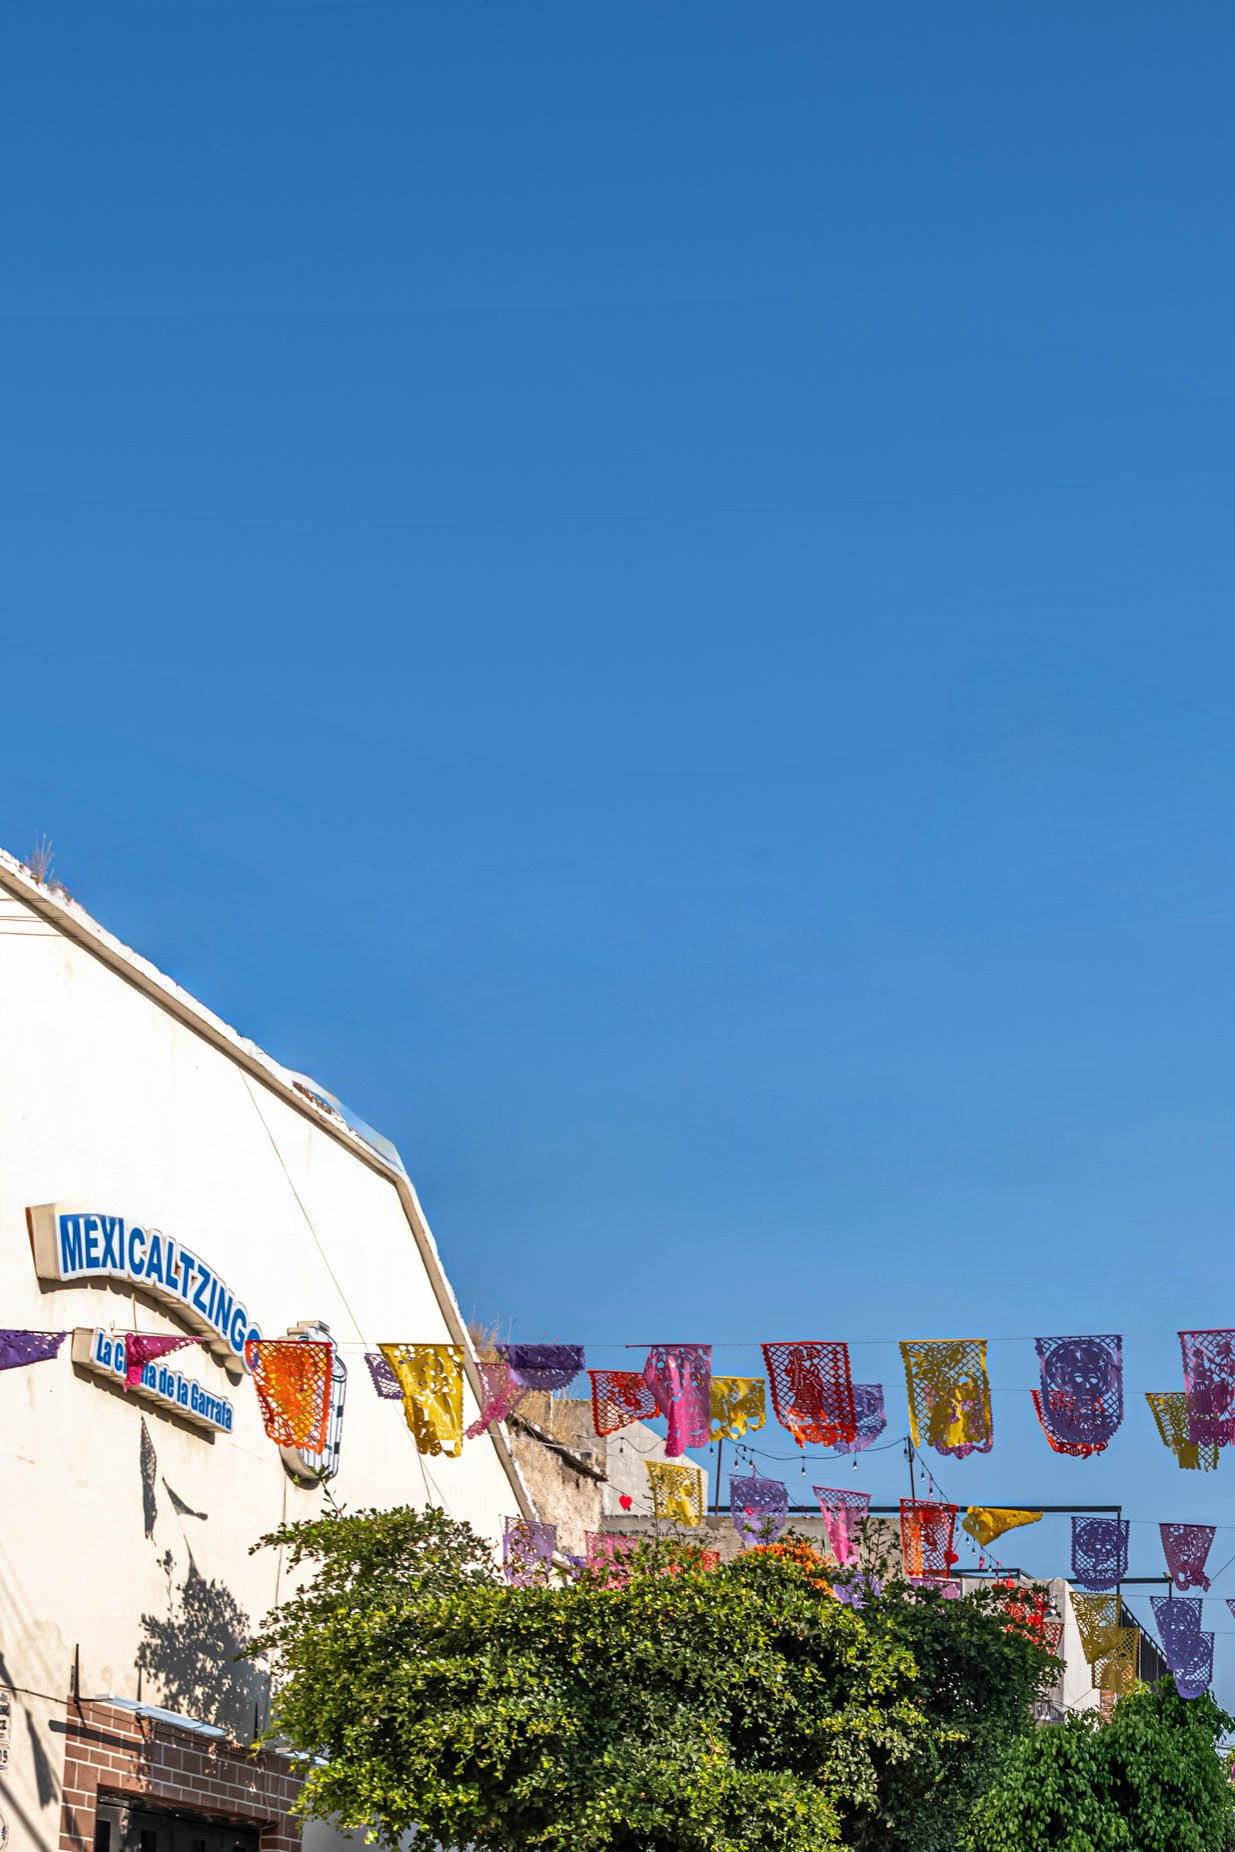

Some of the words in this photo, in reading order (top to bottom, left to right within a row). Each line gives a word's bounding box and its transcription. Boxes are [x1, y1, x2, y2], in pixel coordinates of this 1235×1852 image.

[96, 1332, 112, 1366] La
[159, 1367, 175, 1398] de
[177, 1375, 188, 1406] la
[191, 1383, 232, 1430] Garrafa
